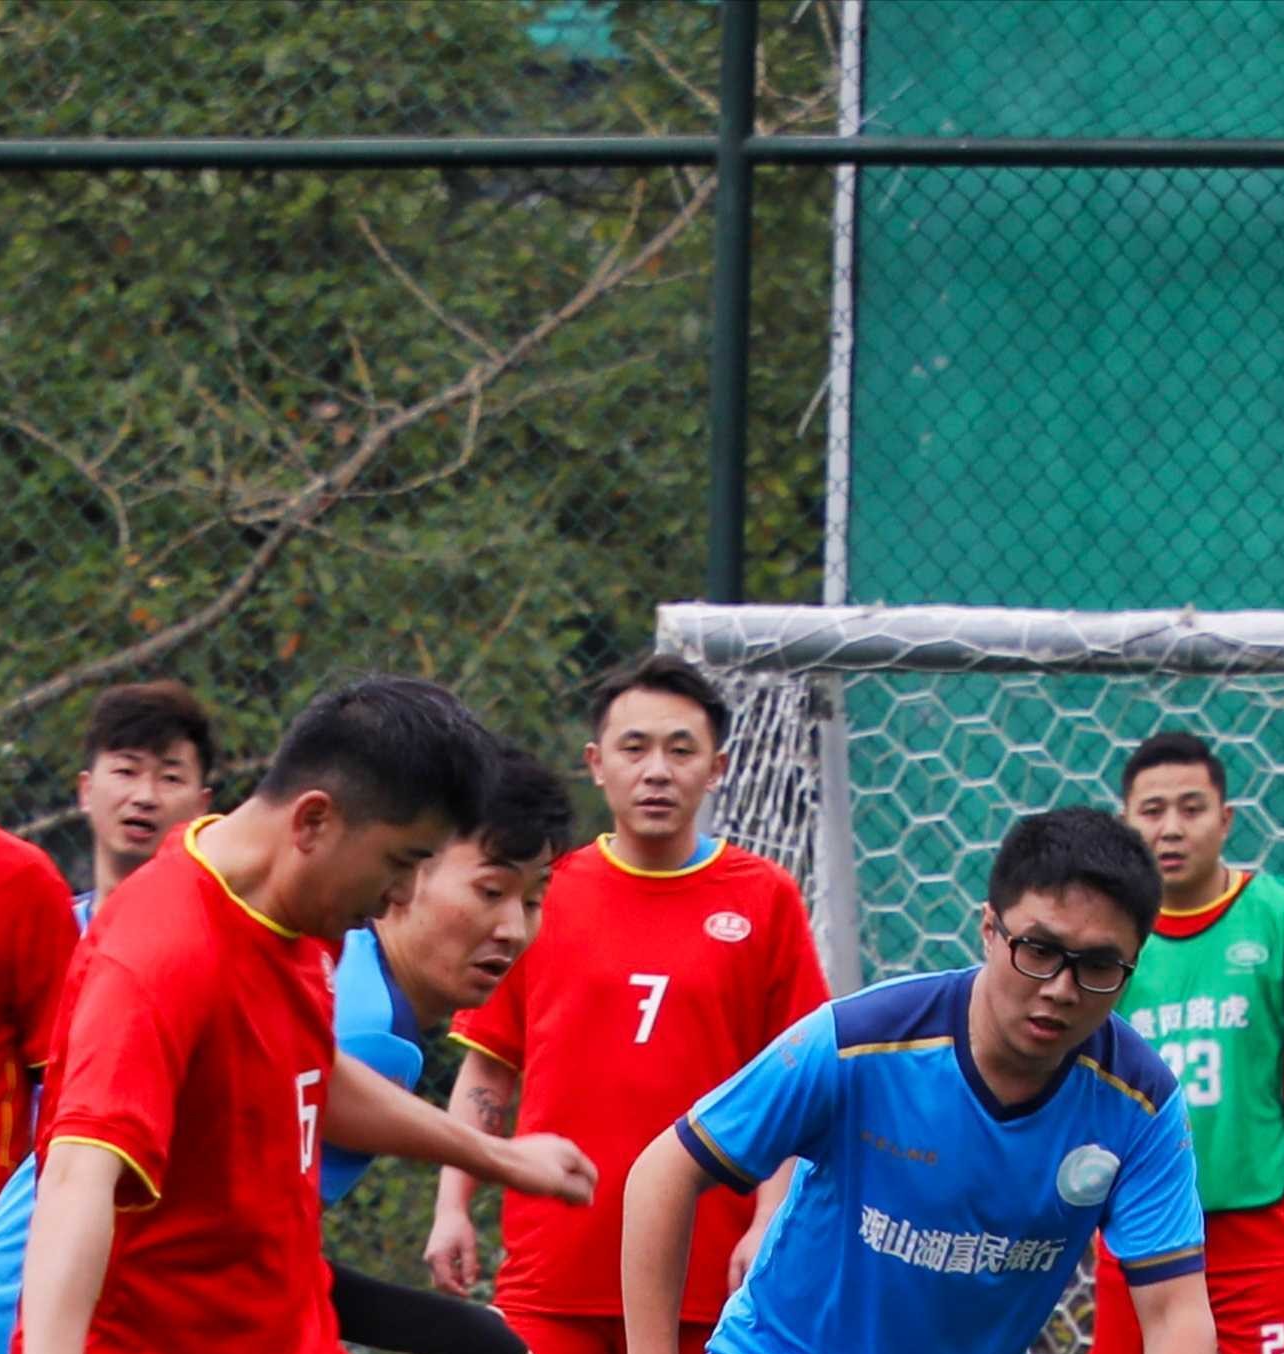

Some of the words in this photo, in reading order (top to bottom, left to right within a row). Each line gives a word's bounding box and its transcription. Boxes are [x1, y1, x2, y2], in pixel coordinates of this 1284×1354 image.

[629, 973, 669, 1044] 7
[858, 1204, 1066, 1275] 观山湖富民银行
